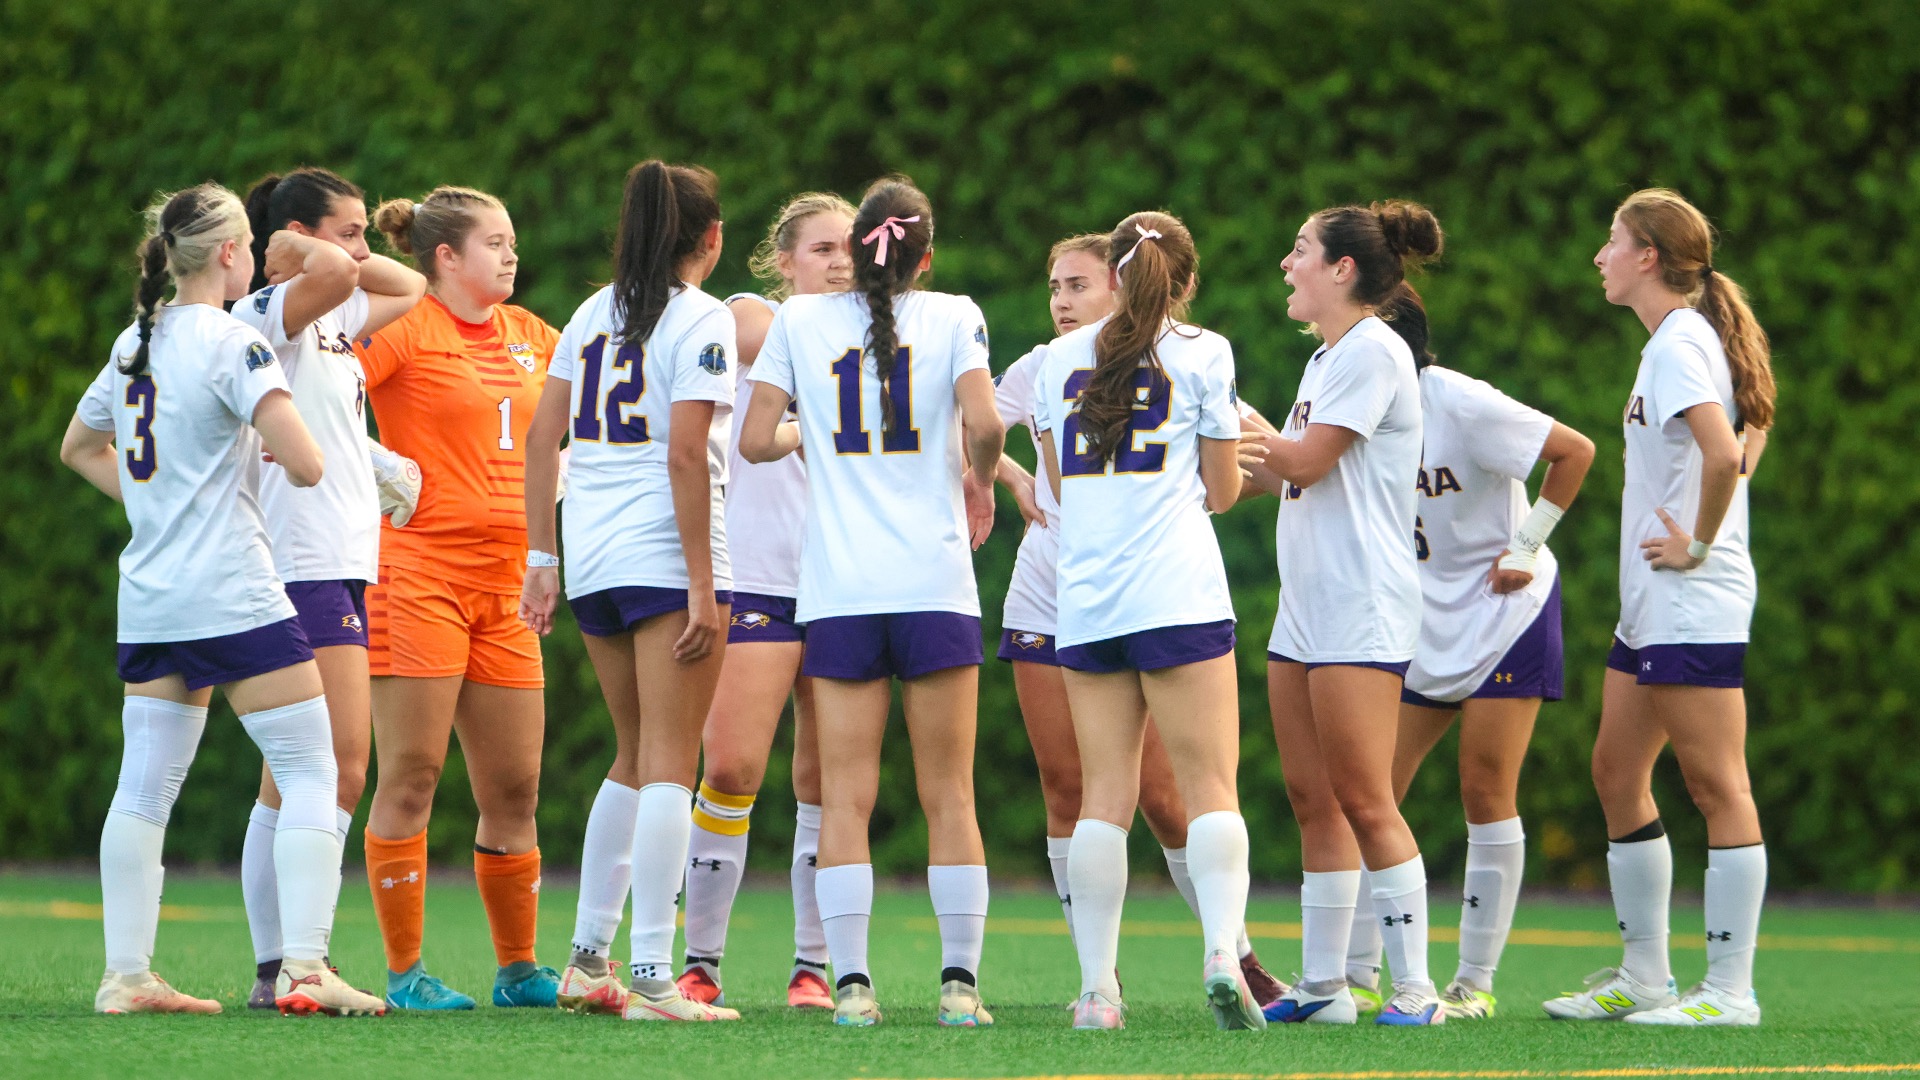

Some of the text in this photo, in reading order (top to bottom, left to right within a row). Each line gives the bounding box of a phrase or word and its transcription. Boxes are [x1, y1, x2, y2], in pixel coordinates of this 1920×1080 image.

[125, 373, 158, 482] 3
[498, 396, 514, 450] 1
[573, 332, 652, 446] 12
[830, 344, 921, 456] 11
[1061, 367, 1174, 480] 22
